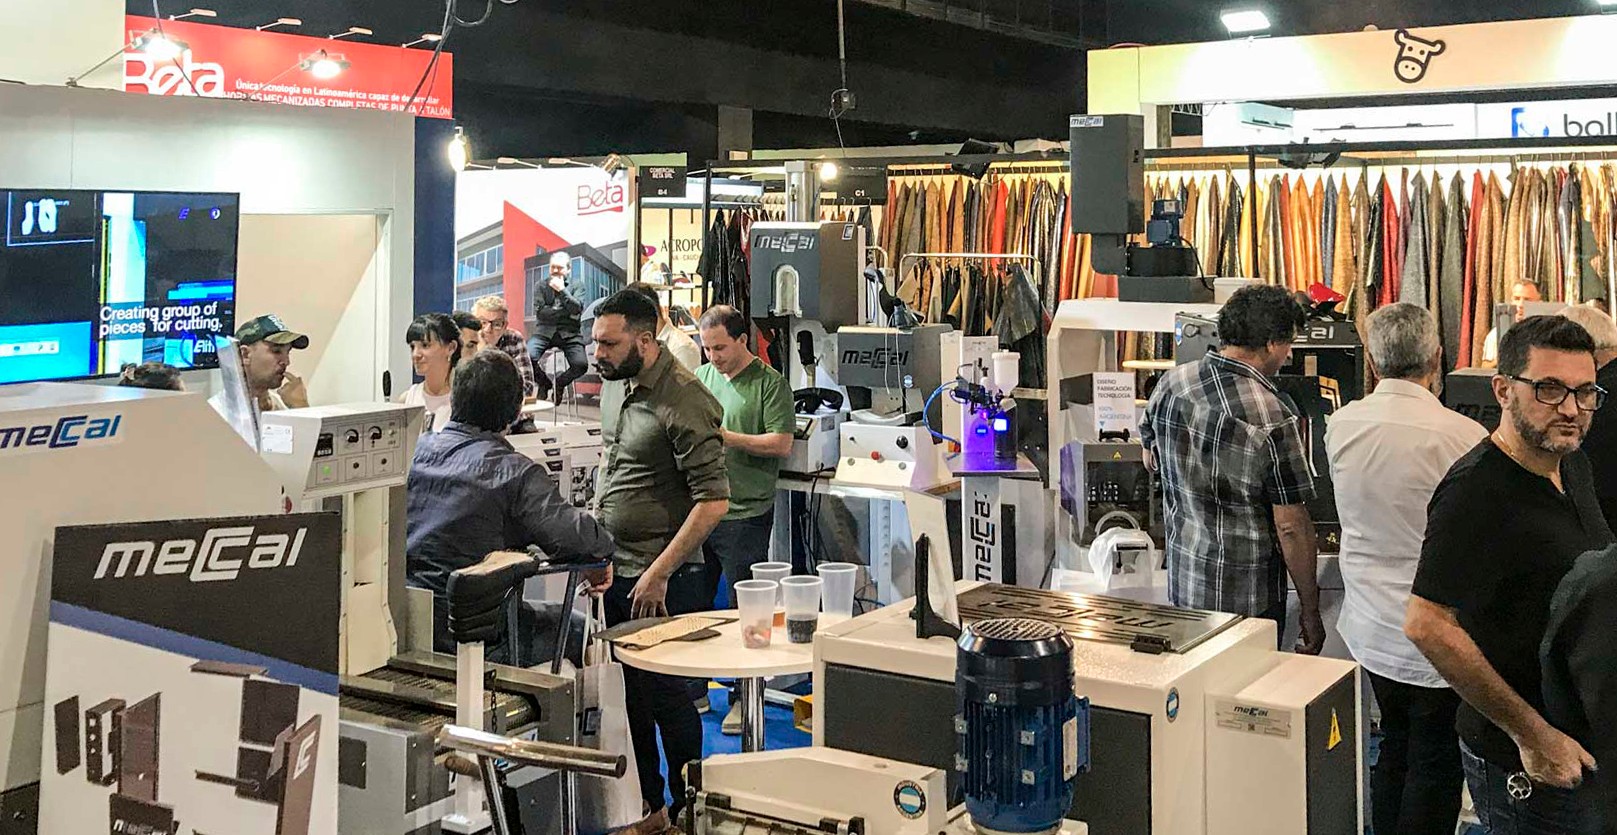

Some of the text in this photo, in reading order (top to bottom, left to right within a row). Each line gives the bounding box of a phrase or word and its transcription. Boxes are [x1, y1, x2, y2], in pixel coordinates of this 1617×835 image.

[122, 47, 224, 97] Beta
[302, 87, 312, 95] en
[314, 86, 366, 101] Latinoamérica
[577, 180, 623, 210] Beta
[854, 189, 866, 197] C1
[100, 301, 218, 322] Creating group of
[99, 320, 146, 339] pieces
